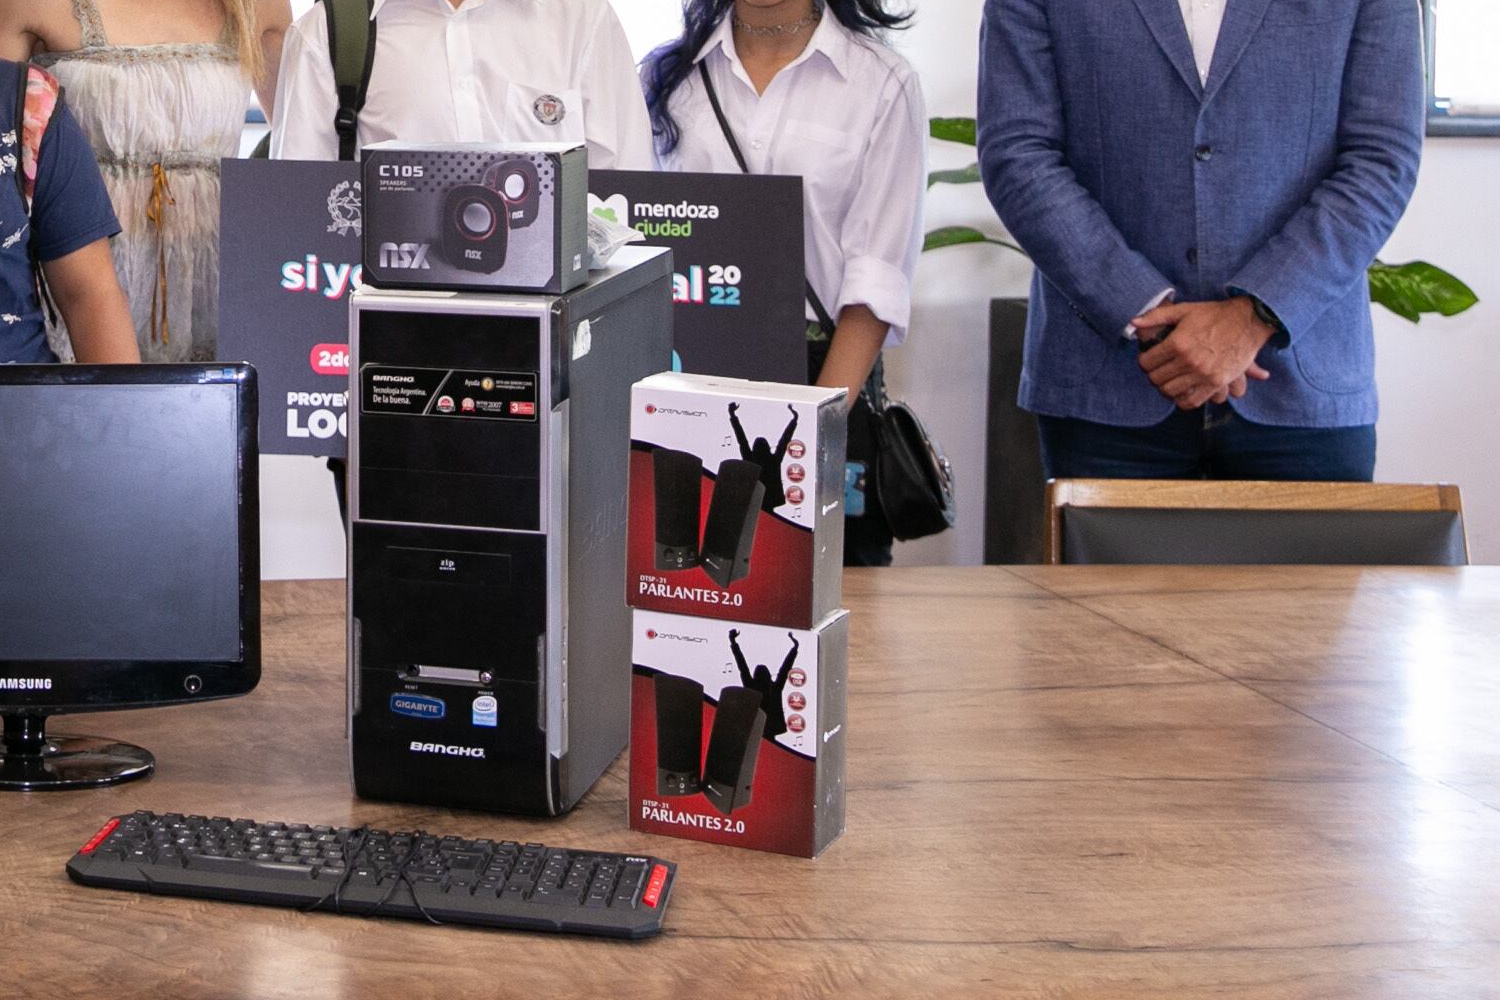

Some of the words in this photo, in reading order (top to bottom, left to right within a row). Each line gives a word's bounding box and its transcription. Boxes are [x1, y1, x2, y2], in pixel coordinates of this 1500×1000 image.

[379, 164, 424, 177] C105
[634, 200, 719, 219] mendoza
[635, 219, 691, 237] ciudad
[708, 265, 742, 285] 20
[709, 285, 741, 306] 22
[287, 392, 347, 407] PROYE
[373, 394, 382, 403] De
[383, 395, 389, 403] la
[390, 396, 412, 404] buena.
[511, 403, 519, 412] 3
[639, 581, 719, 604] PARLANTES
[721, 591, 743, 606] 2.0
[395, 699, 438, 713] GIGABYTE
[642, 806, 722, 830] PARLANTES
[724, 818, 745, 834] 2.0
